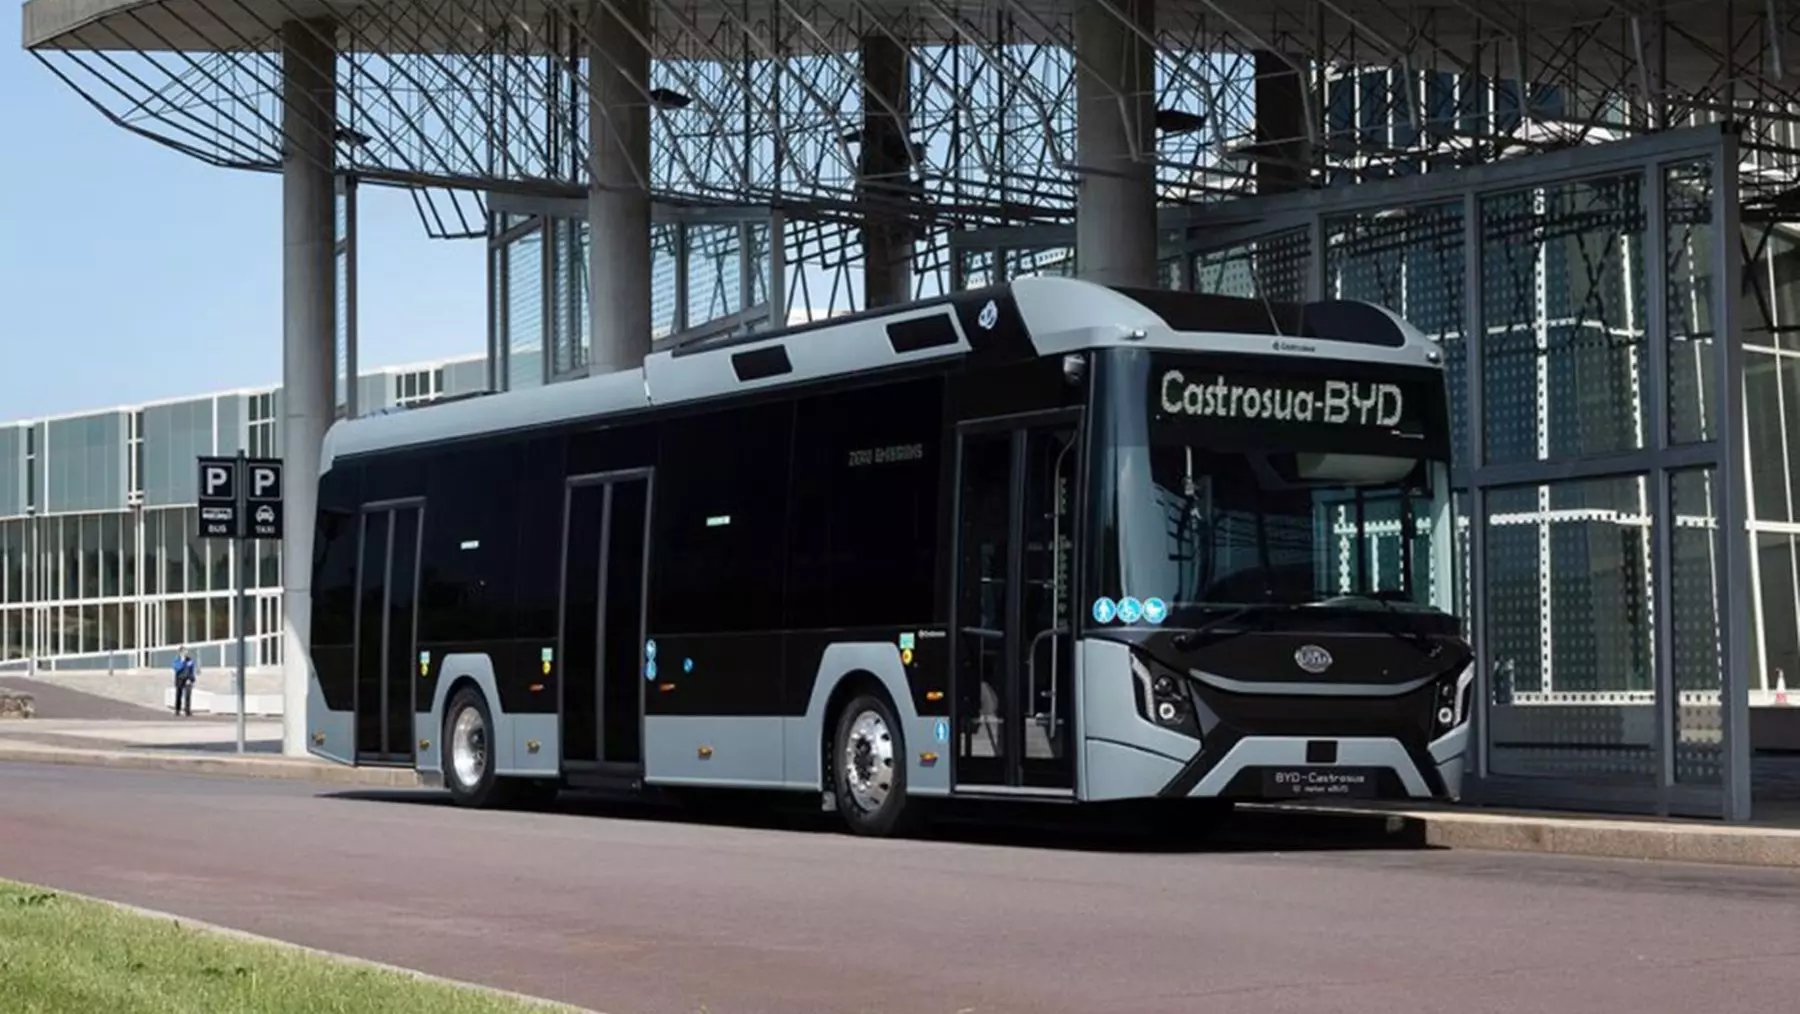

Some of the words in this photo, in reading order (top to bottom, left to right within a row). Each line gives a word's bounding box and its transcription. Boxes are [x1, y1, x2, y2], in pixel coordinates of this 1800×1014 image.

[1161, 370, 1402, 427] Castrosua-BYD
[207, 467, 227, 495] P
[255, 468, 275, 496] P
